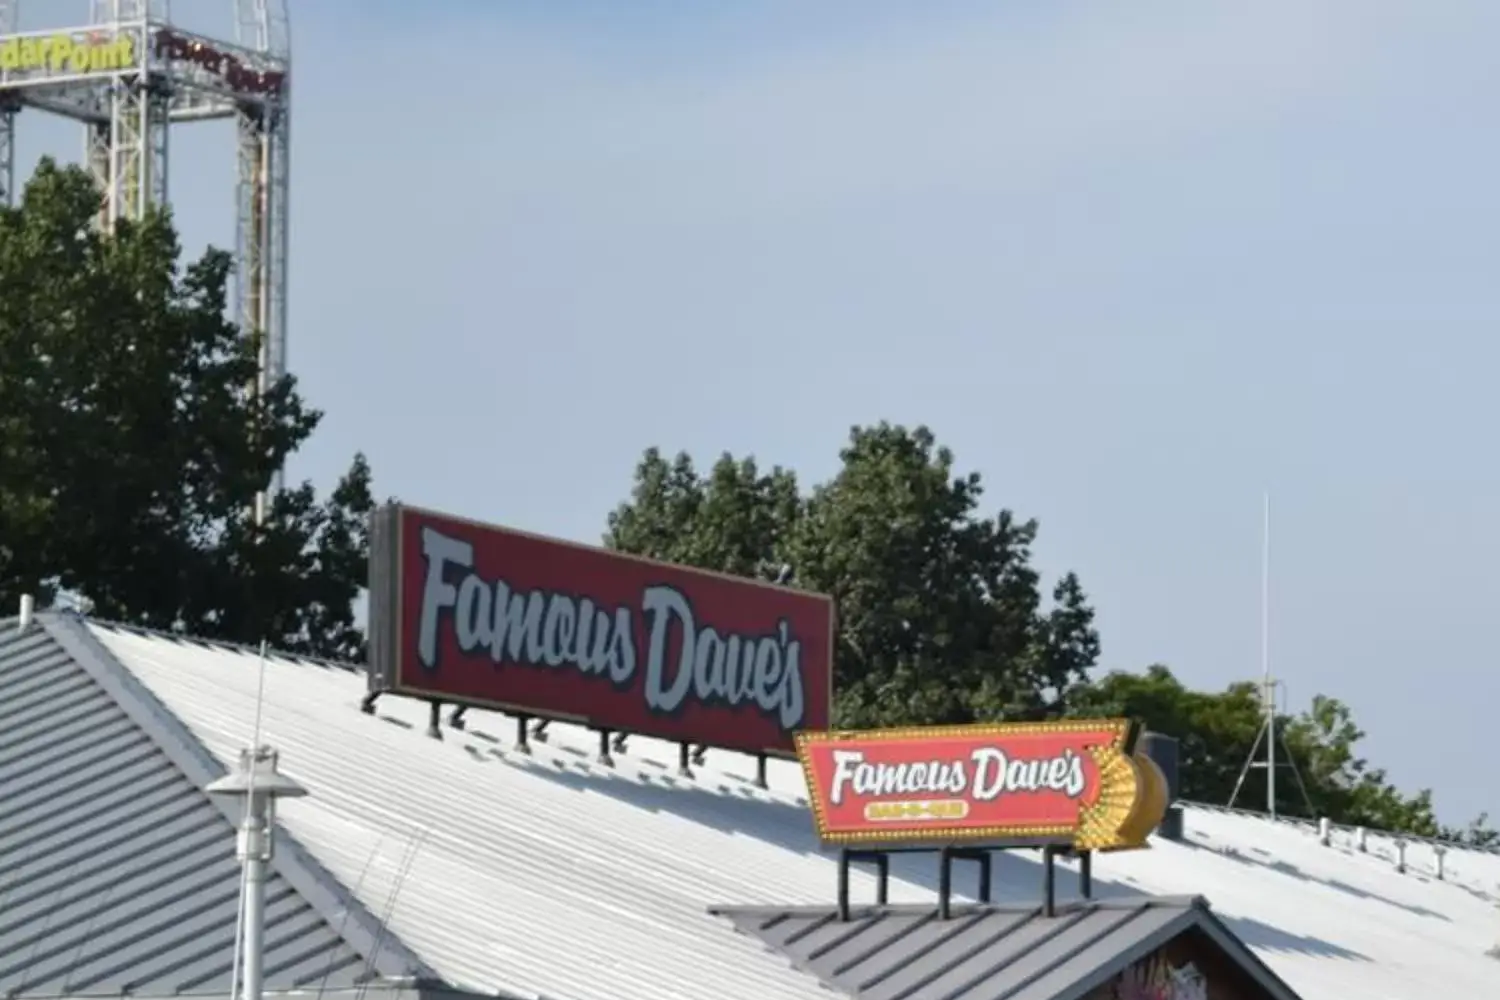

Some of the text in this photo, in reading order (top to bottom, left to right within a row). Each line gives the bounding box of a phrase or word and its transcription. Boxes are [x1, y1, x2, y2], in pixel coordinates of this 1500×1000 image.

[419, 525, 804, 730] Famous Dave's
[830, 747, 1085, 804] Famous Dave's
